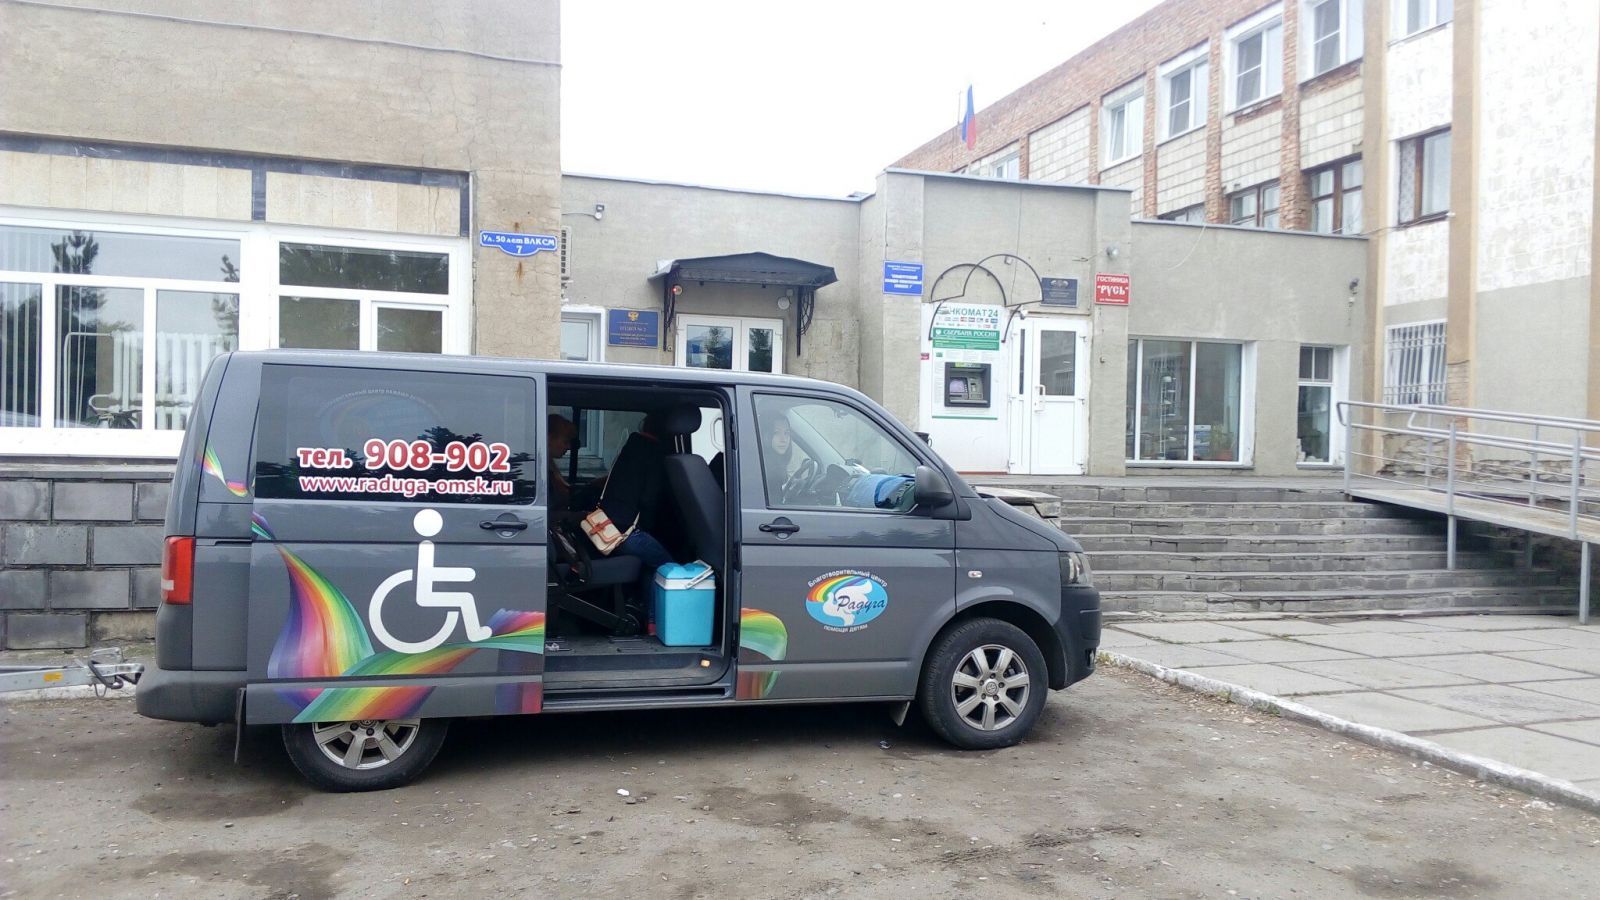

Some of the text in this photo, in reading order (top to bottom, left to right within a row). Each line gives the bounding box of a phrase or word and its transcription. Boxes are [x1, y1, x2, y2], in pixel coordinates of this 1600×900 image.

[483, 234, 495, 242] Ул.
[524, 237, 555, 246] ВЛКСМ
[516, 245, 522, 254] 7
[298, 438, 511, 472] тел. 908-902
[299, 474, 514, 497] www.raduga-omsk.ru
[837, 595, 885, 615] Радуга
